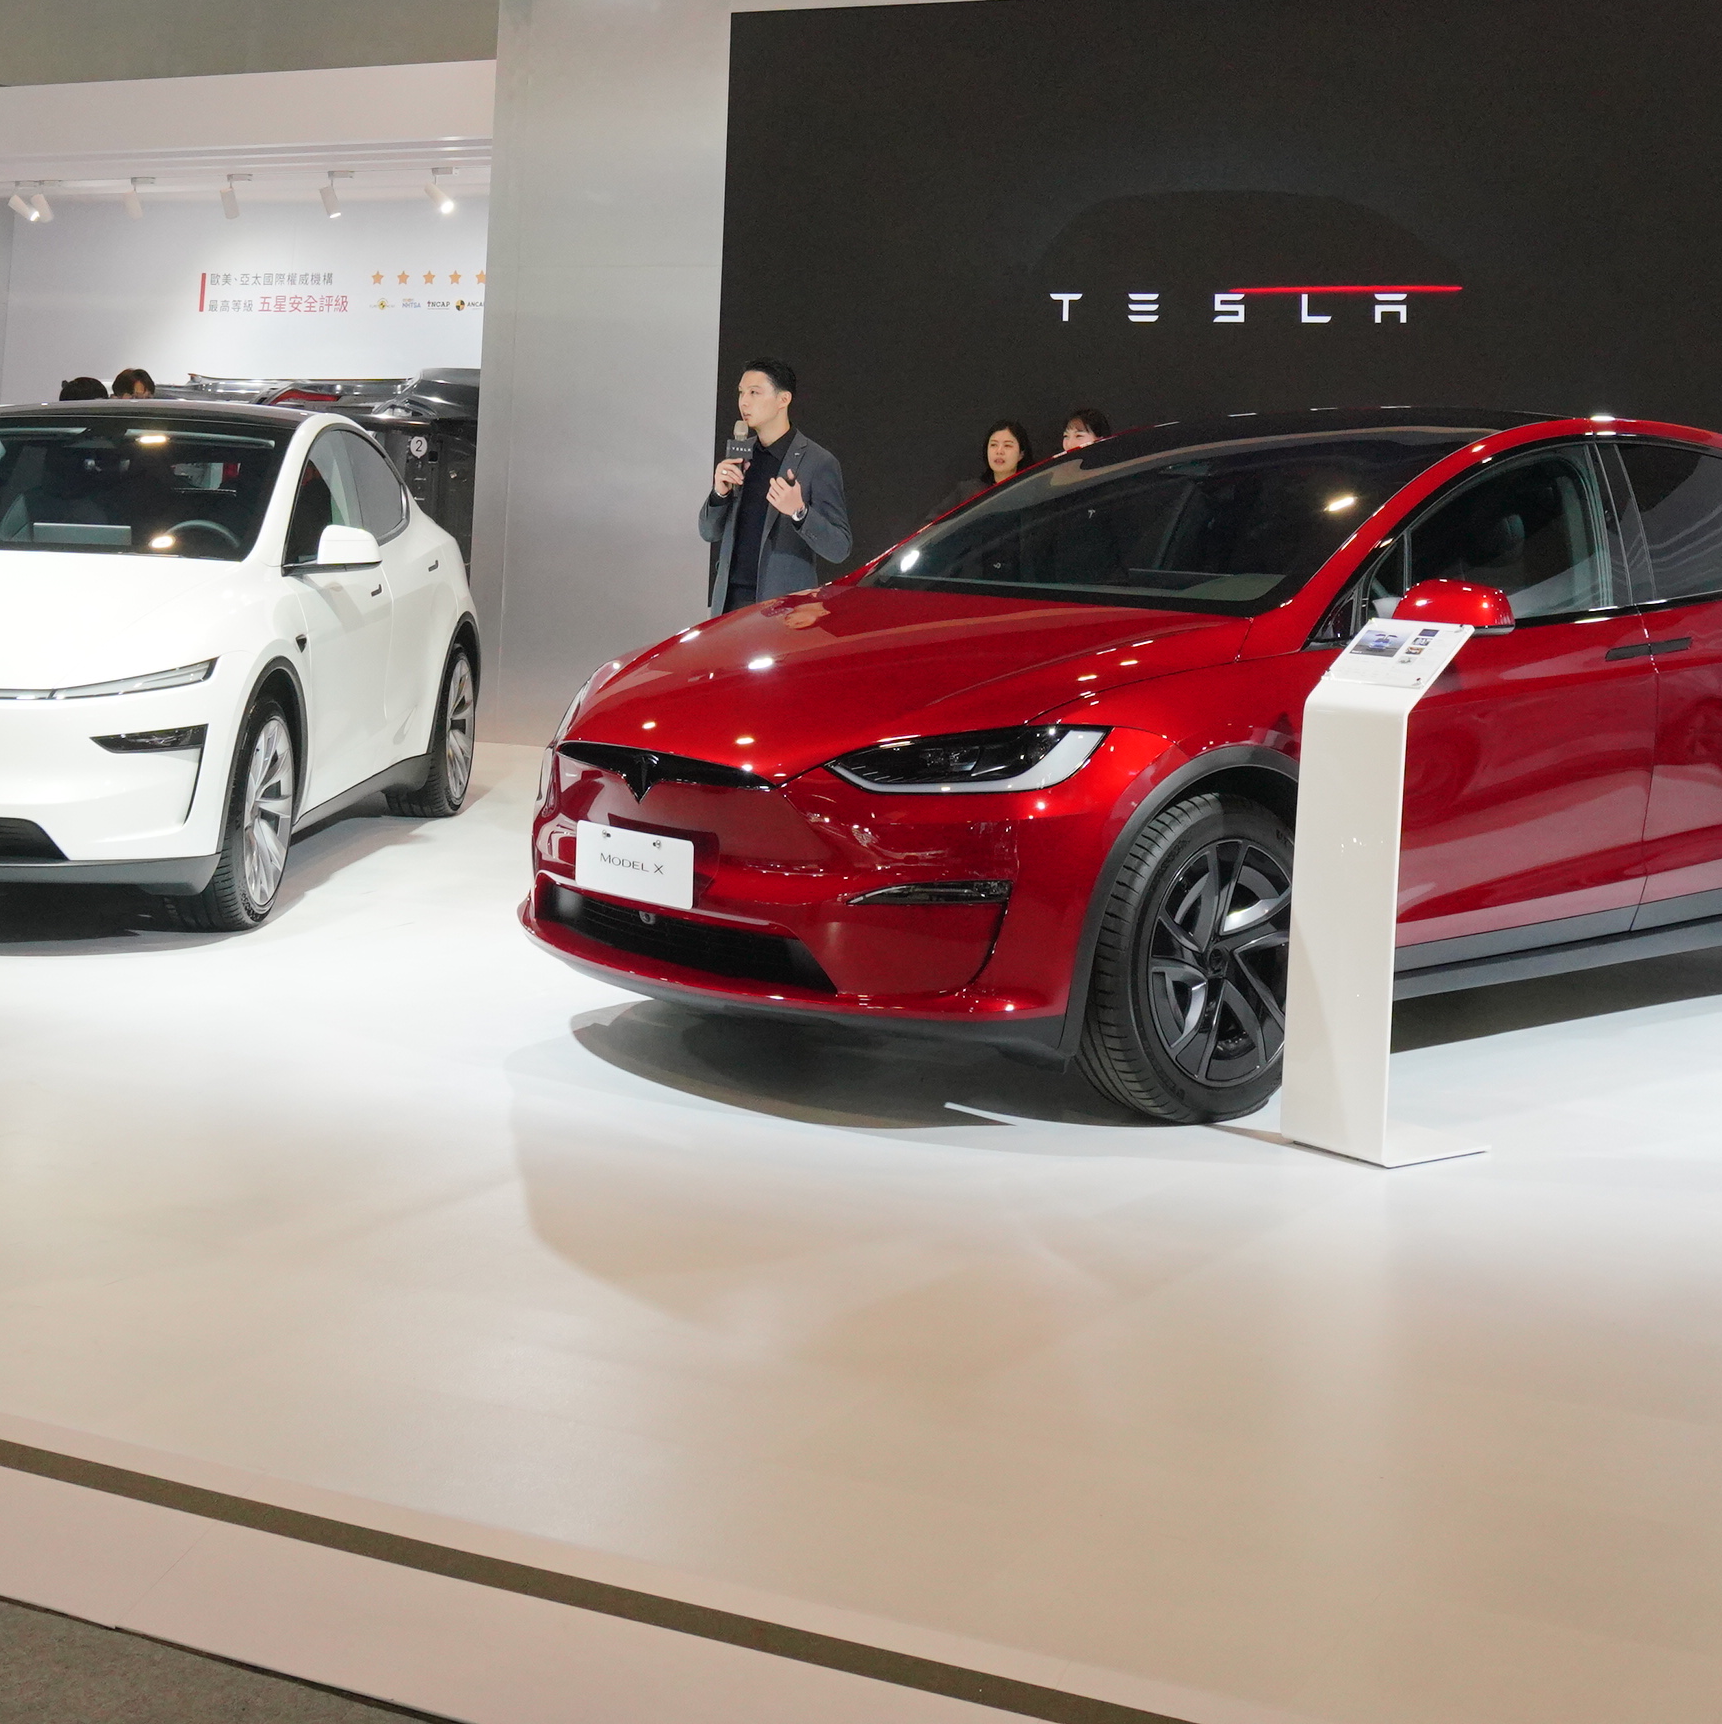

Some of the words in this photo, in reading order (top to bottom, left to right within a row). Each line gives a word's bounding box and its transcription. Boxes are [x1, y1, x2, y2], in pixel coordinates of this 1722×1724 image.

[208, 299, 254, 313] 最高等級
[257, 294, 350, 314] 五星安全評級
[1049, 293, 1408, 324] TESLA
[600, 853, 649, 873] MODEL
[654, 863, 664, 875] X
